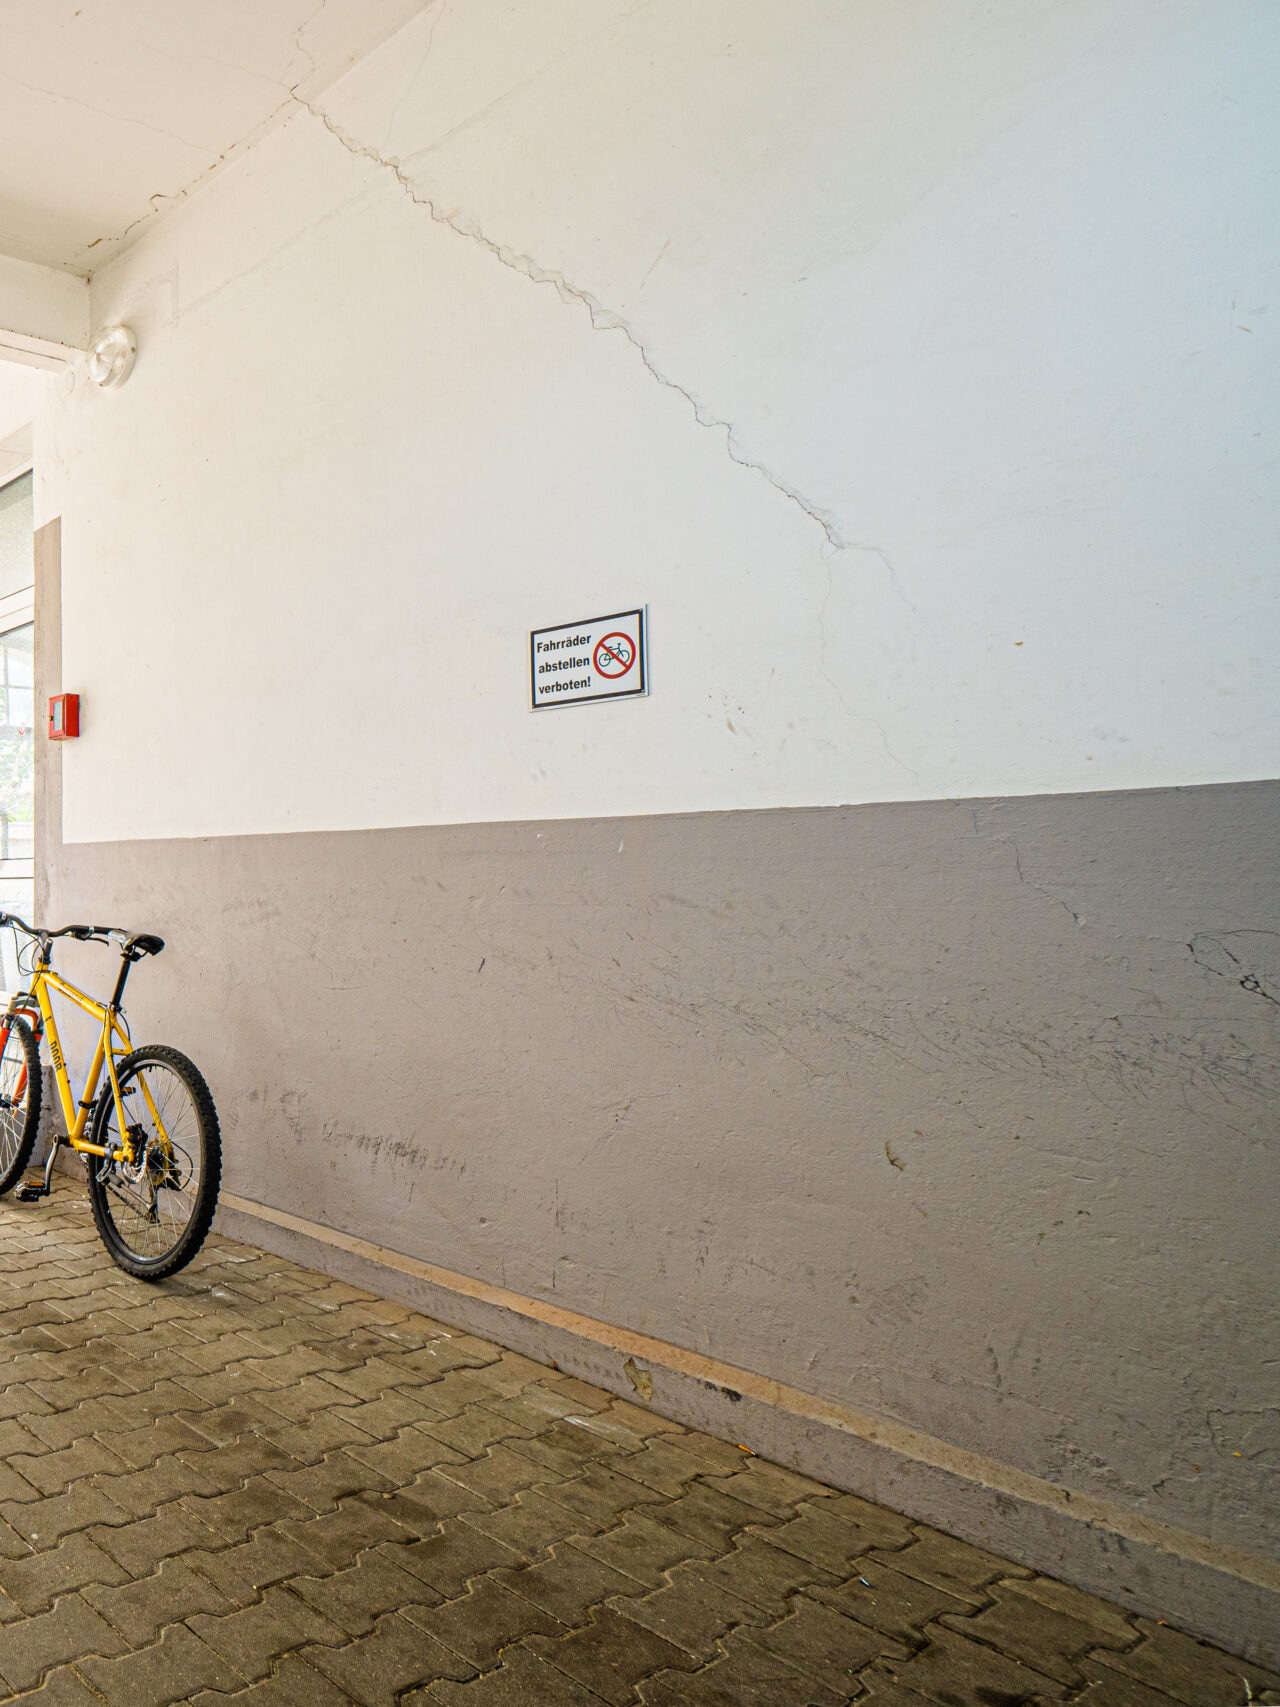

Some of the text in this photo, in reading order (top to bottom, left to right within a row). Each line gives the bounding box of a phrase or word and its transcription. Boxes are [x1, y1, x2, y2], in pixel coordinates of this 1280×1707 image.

[536, 634, 592, 653] Fahrräder
[538, 657, 590, 674] abstellen
[538, 676, 591, 694] verboten!
